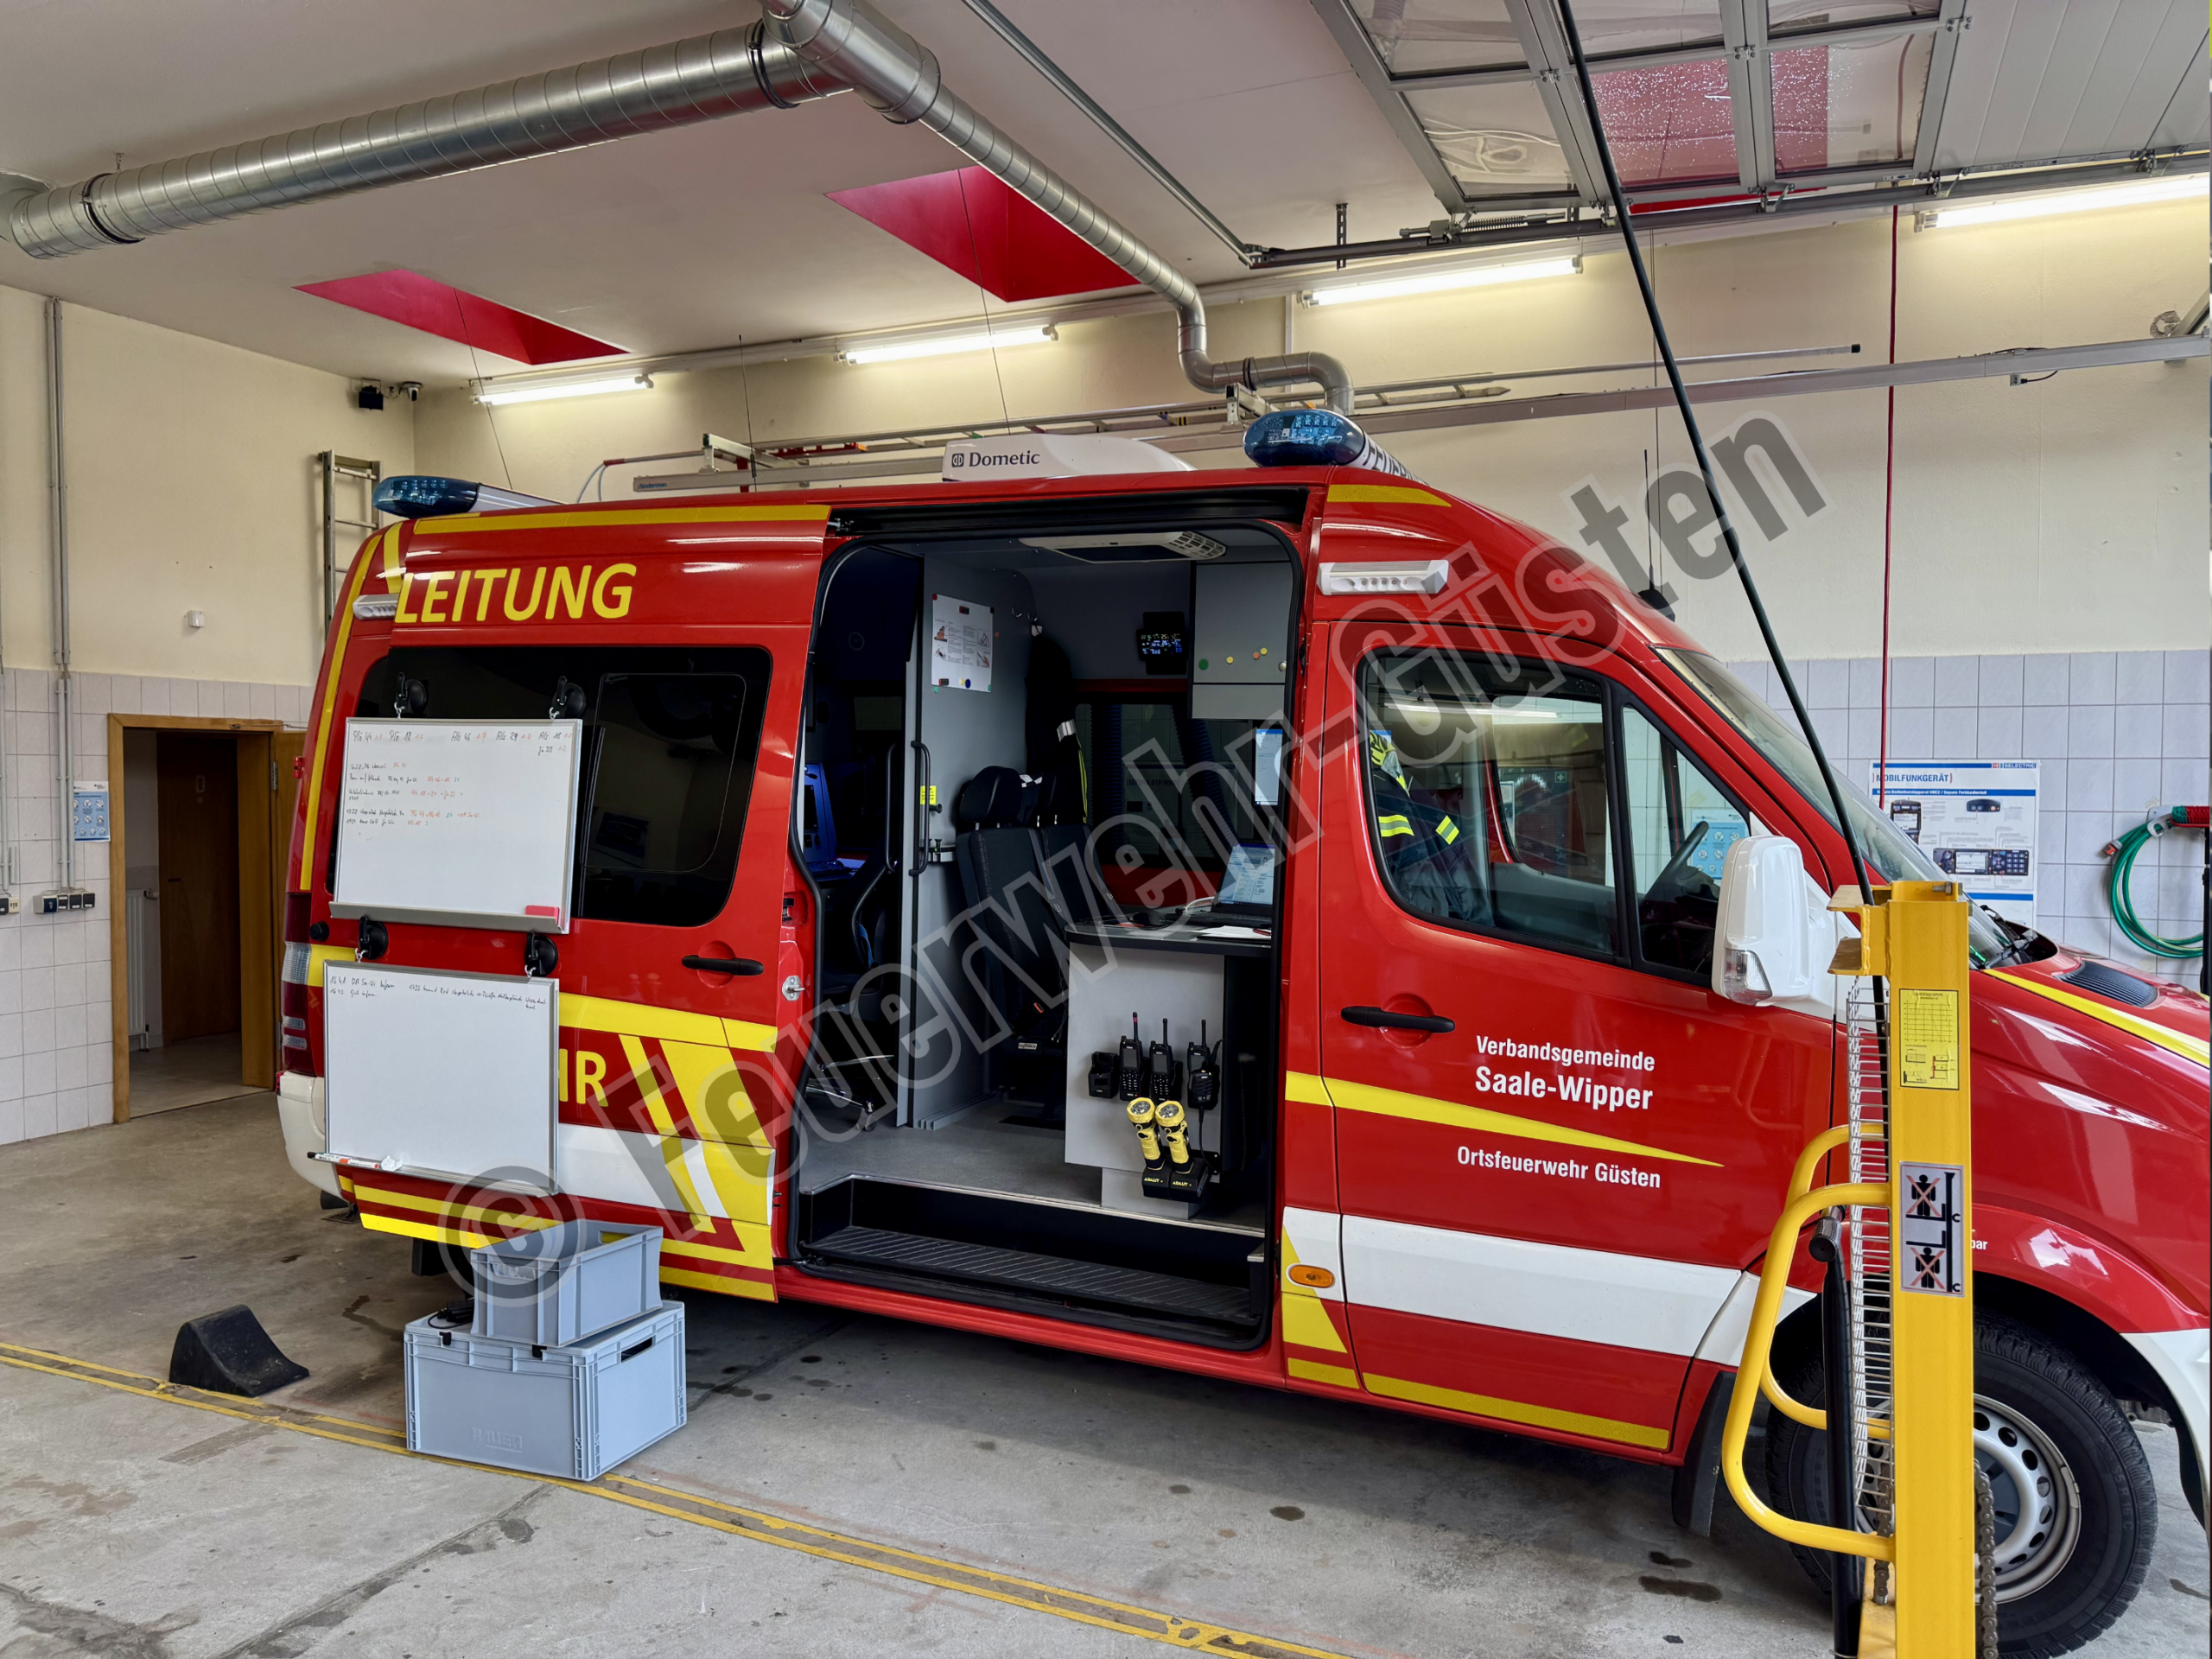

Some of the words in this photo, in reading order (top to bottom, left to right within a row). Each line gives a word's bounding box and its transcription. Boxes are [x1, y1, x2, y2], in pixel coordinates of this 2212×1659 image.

[969, 450, 1040, 467] Dometic
[395, 563, 637, 624] LEITUNG
[1876, 772, 1948, 782] MOBILFUNKGERÄT
[1476, 1035, 1656, 1071] Verbandsgemeinde
[1475, 1065, 1654, 1112] Saale-Wipper
[1458, 1146, 1589, 1179] Ortsfeuerwehr
[1594, 1162, 1661, 1188] Güsten
